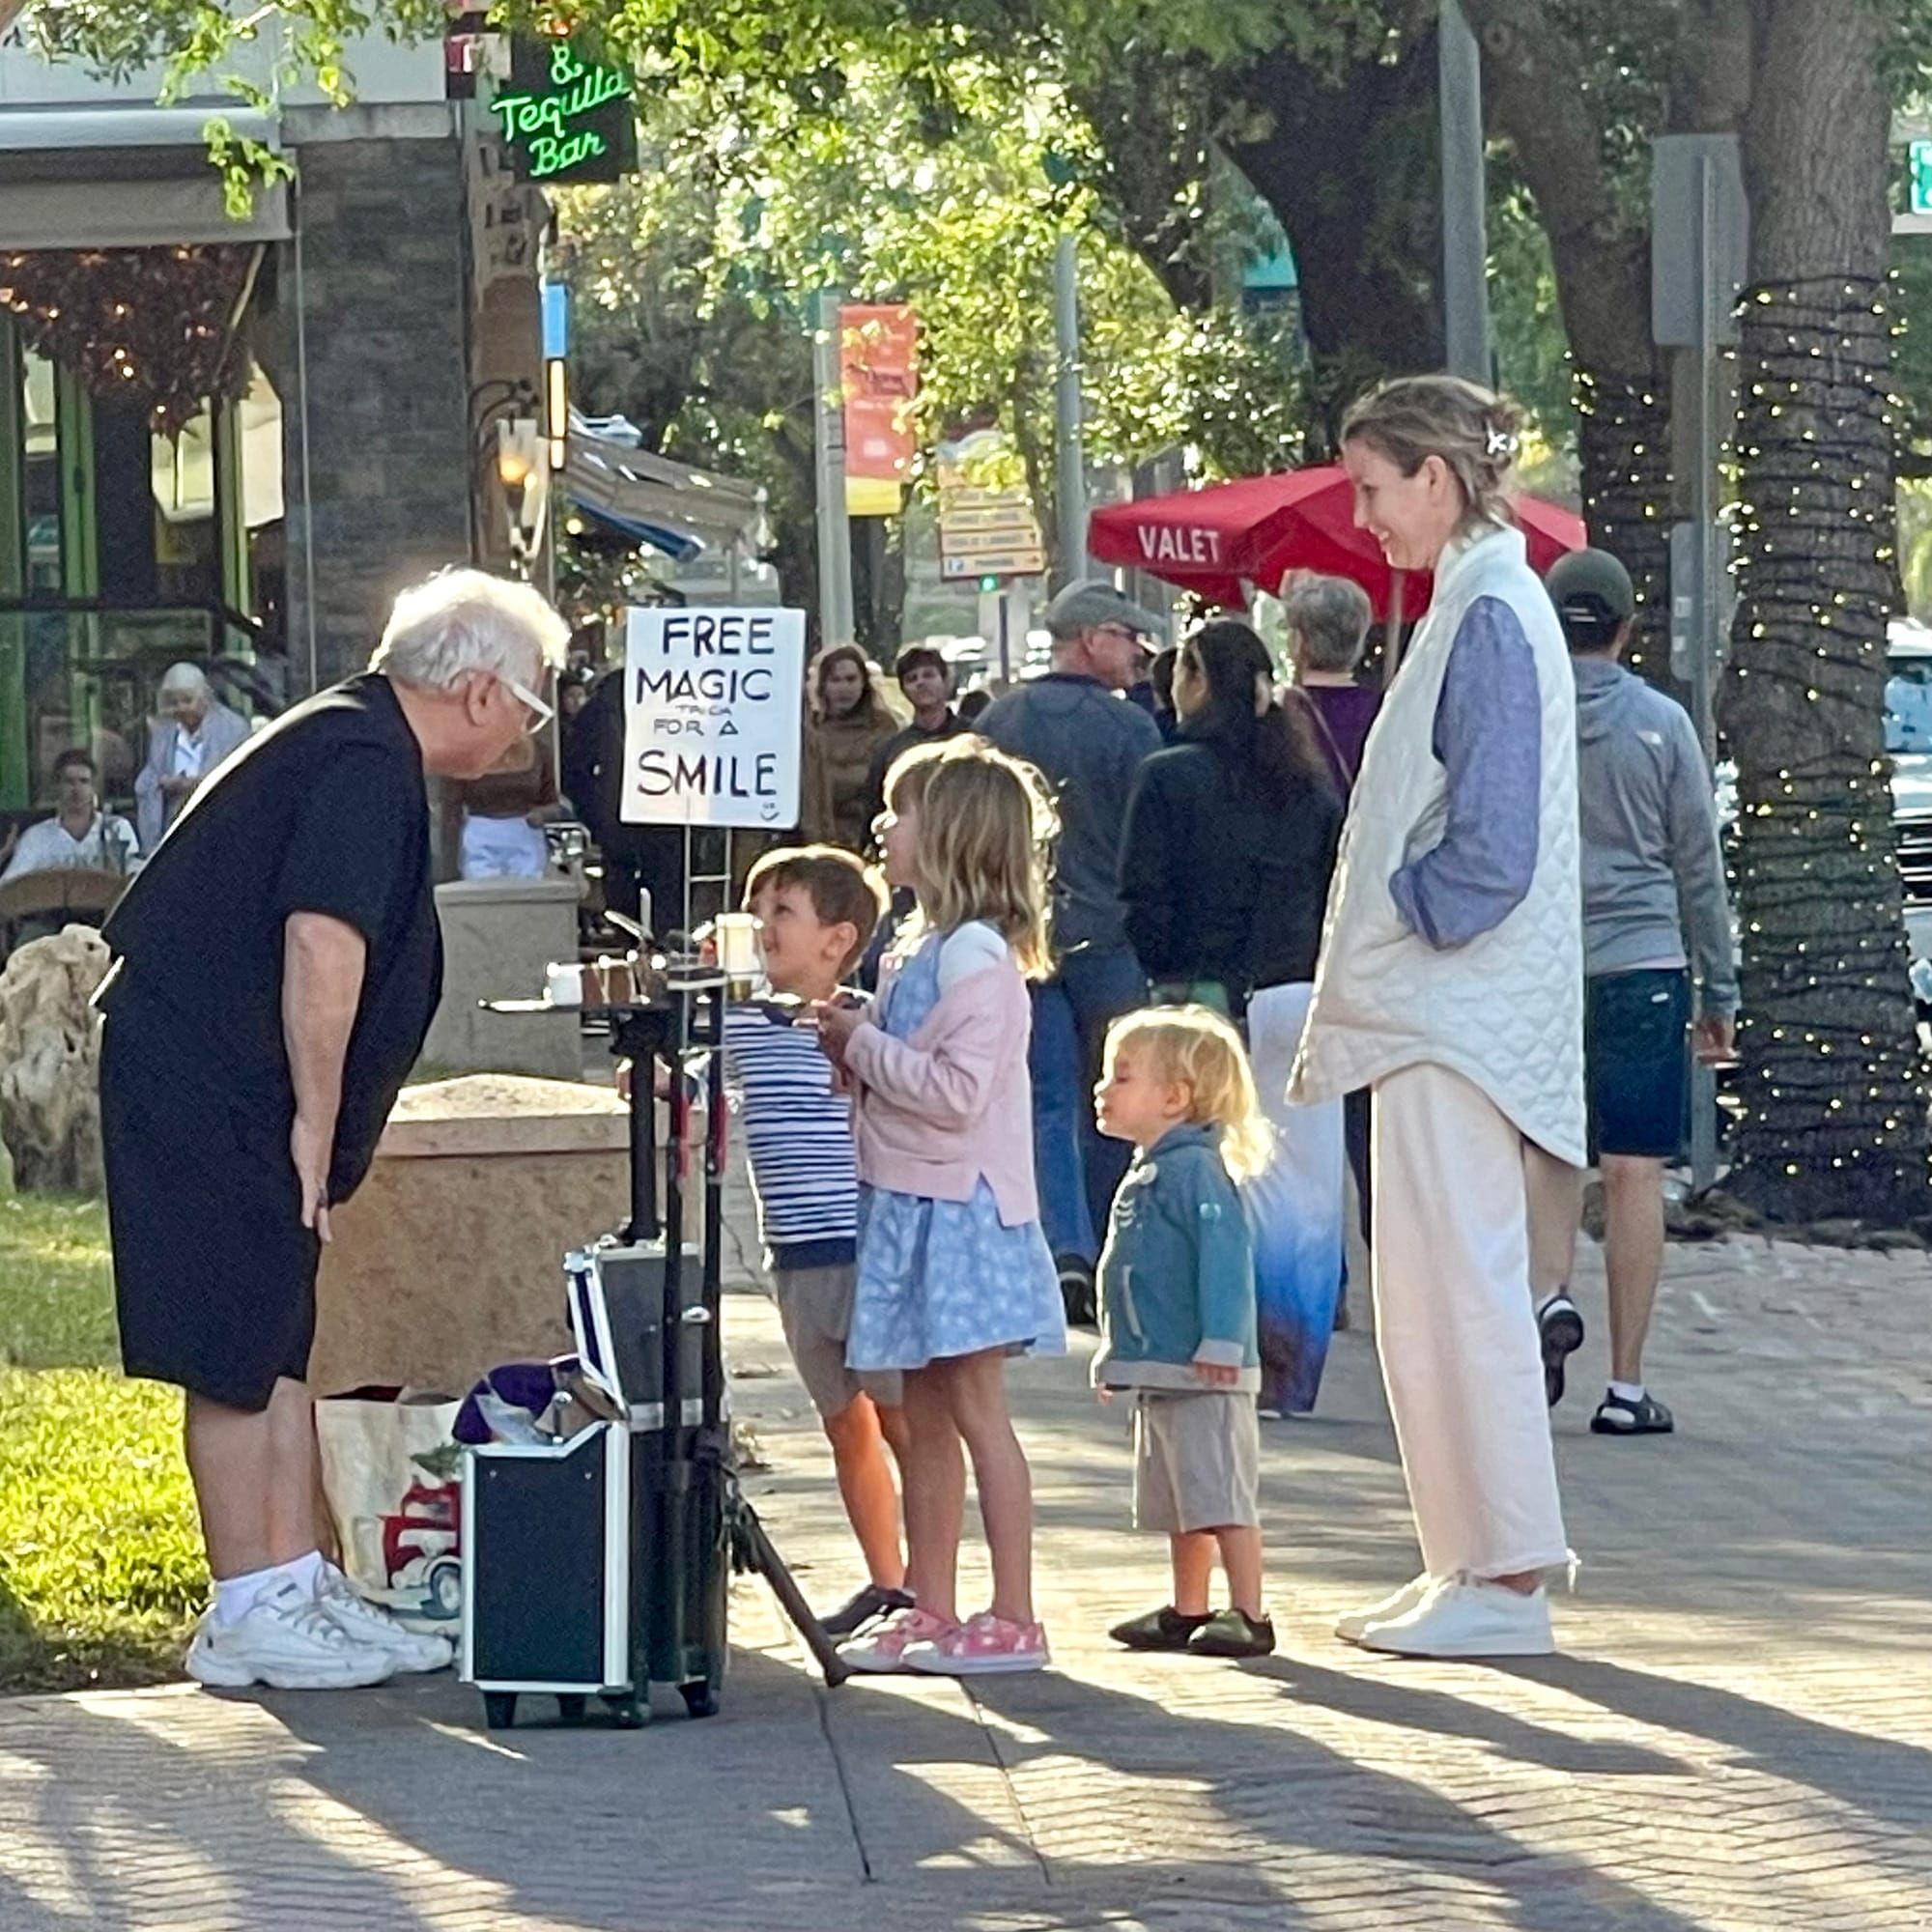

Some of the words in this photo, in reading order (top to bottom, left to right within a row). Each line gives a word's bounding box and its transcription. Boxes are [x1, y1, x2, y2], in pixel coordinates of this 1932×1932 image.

[551, 39, 583, 85] &
[529, 132, 607, 177] Bar
[1138, 526, 1220, 564] VALET
[663, 615, 775, 658] FREE
[636, 668, 774, 704] MAGIC
[653, 718, 704, 736] FOR
[719, 720, 739, 736] A
[637, 750, 777, 798] SMILE
